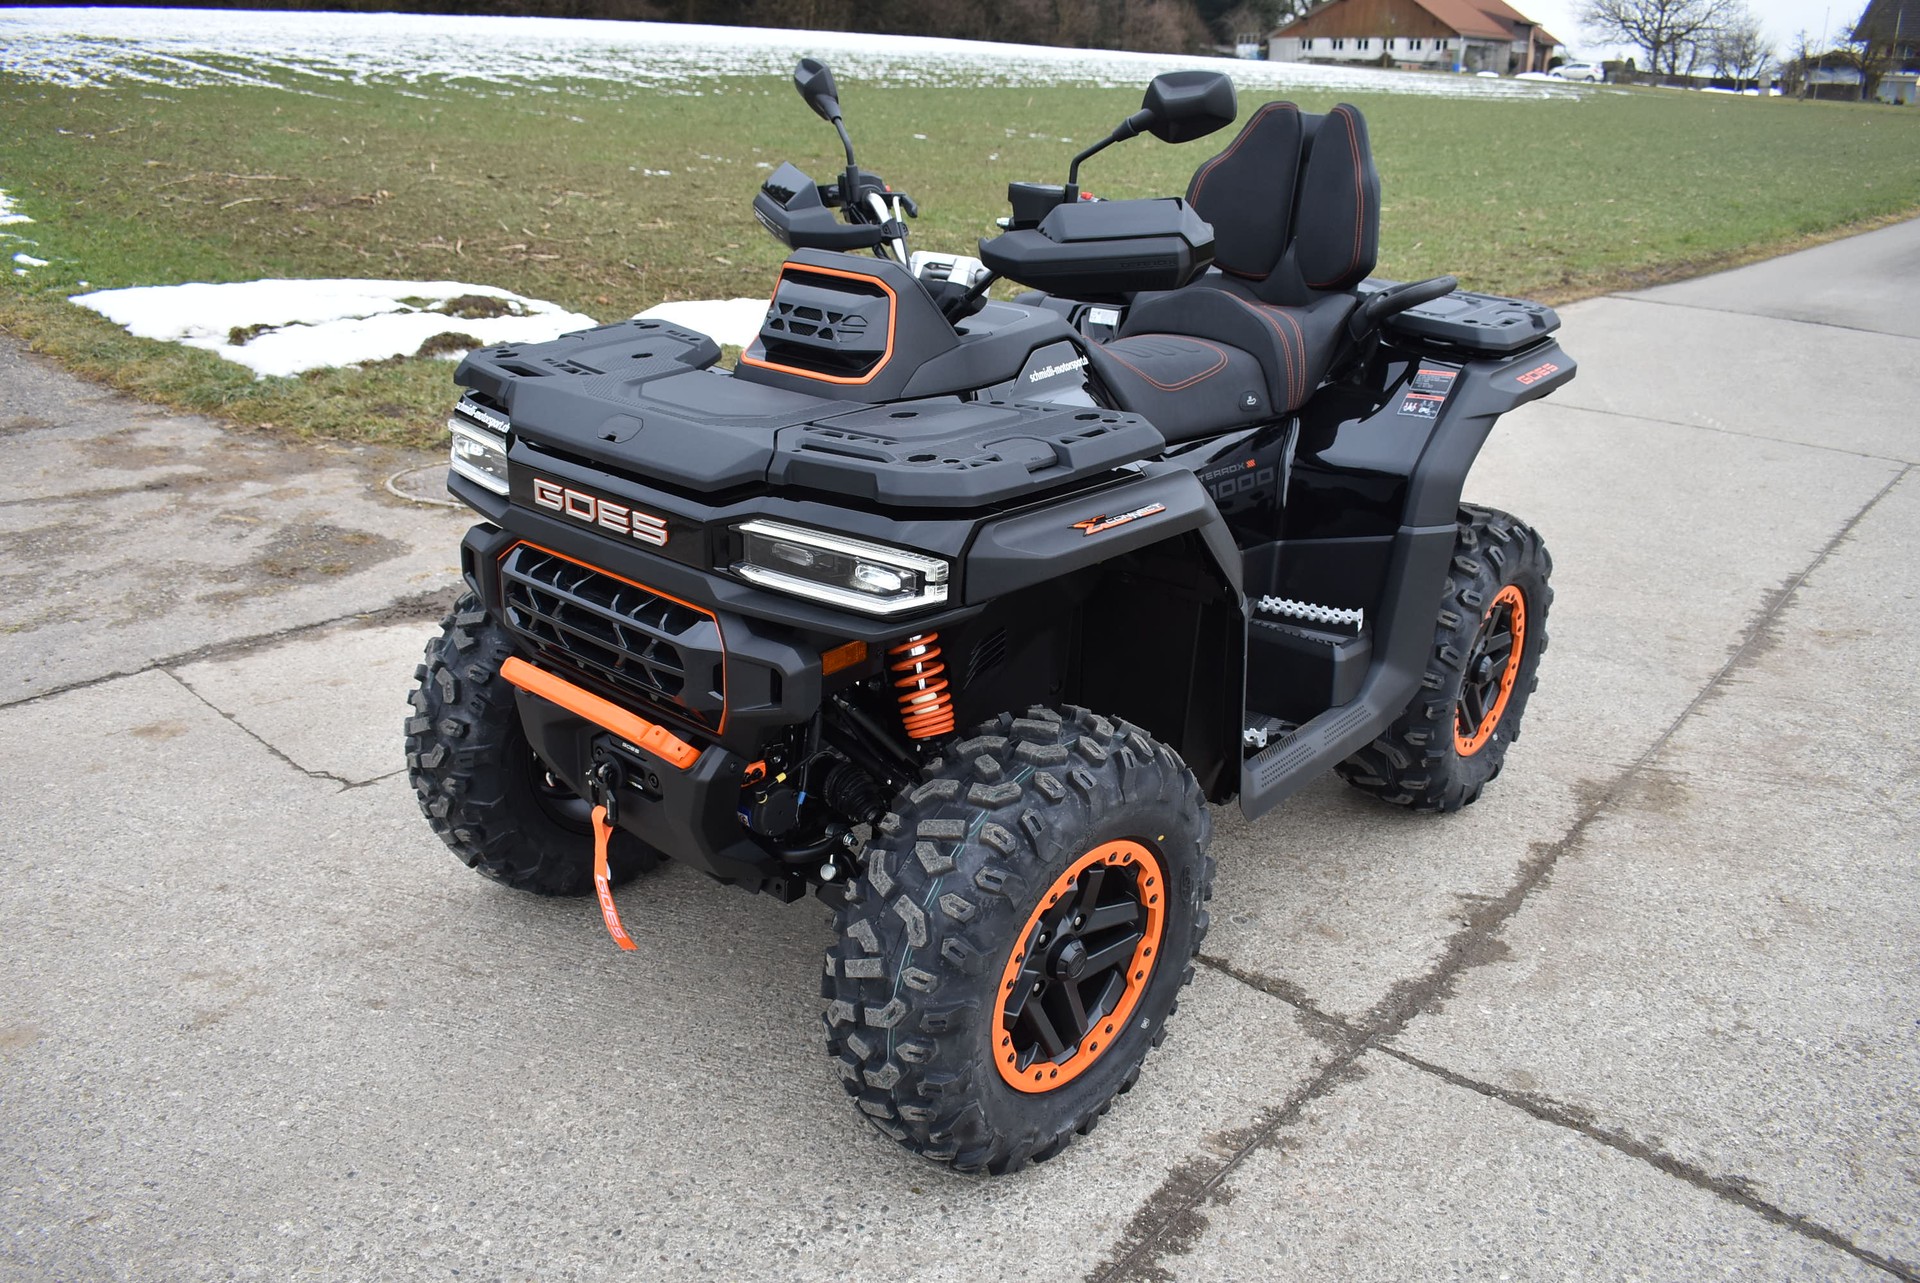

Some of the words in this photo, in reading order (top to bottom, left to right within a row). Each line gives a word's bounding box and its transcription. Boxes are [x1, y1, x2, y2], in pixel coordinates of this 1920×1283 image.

[1516, 363, 1559, 384] GOES
[1209, 467, 1274, 499] 1000
[534, 478, 668, 546] GOES
[597, 874, 626, 938] GOES
